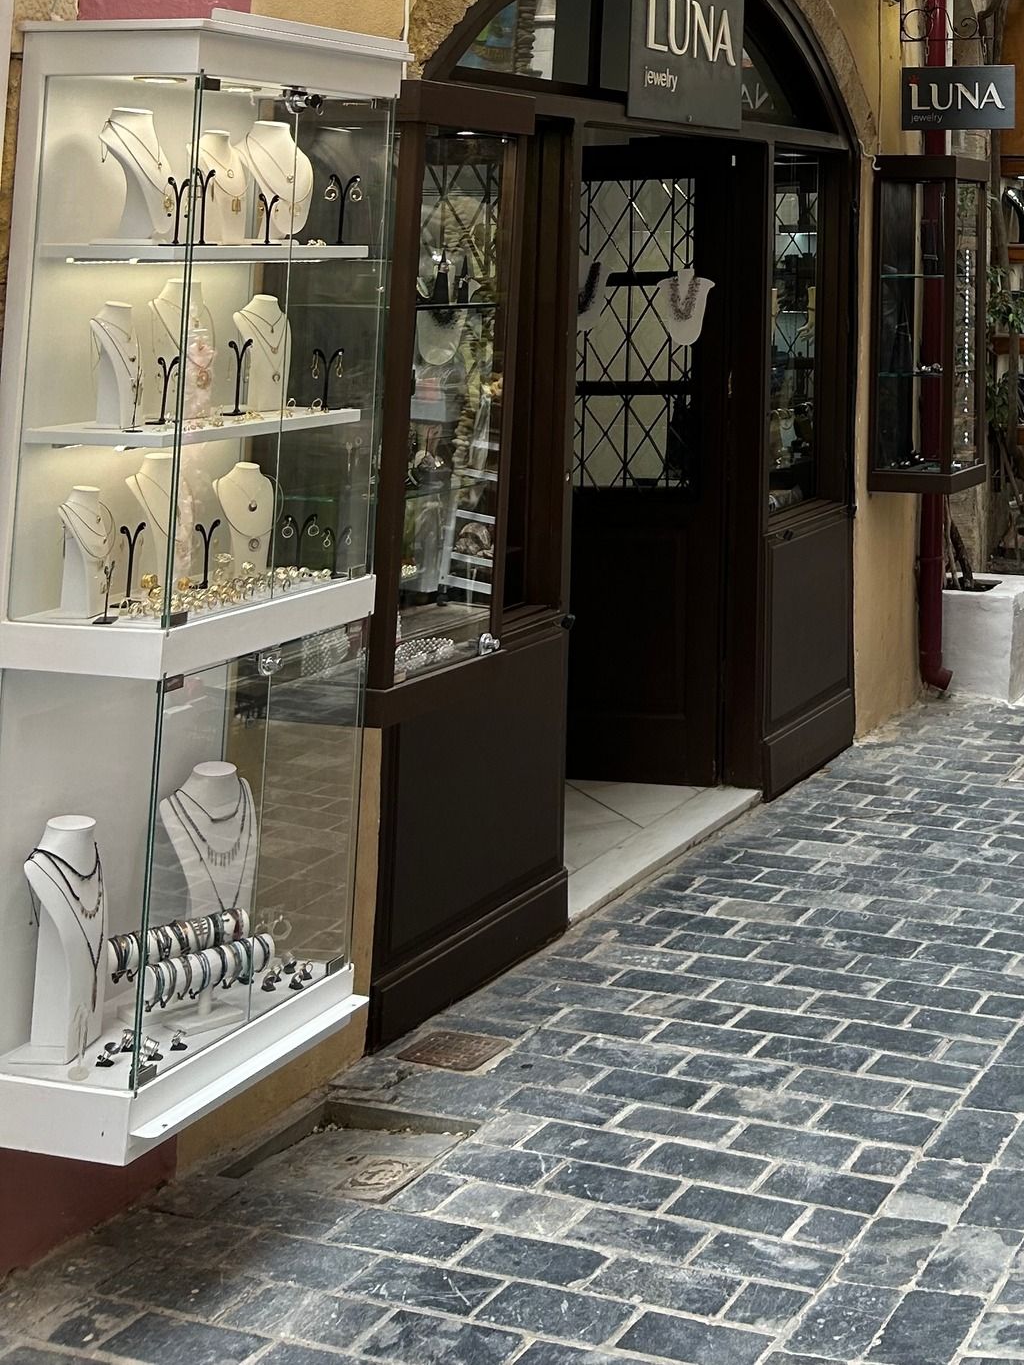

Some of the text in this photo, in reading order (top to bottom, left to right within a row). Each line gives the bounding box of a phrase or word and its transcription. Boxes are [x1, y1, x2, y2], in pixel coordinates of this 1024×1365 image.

[643, 66, 678, 92] jewelry
[908, 81, 1006, 110] LUNA
[911, 112, 943, 124] jewelry
